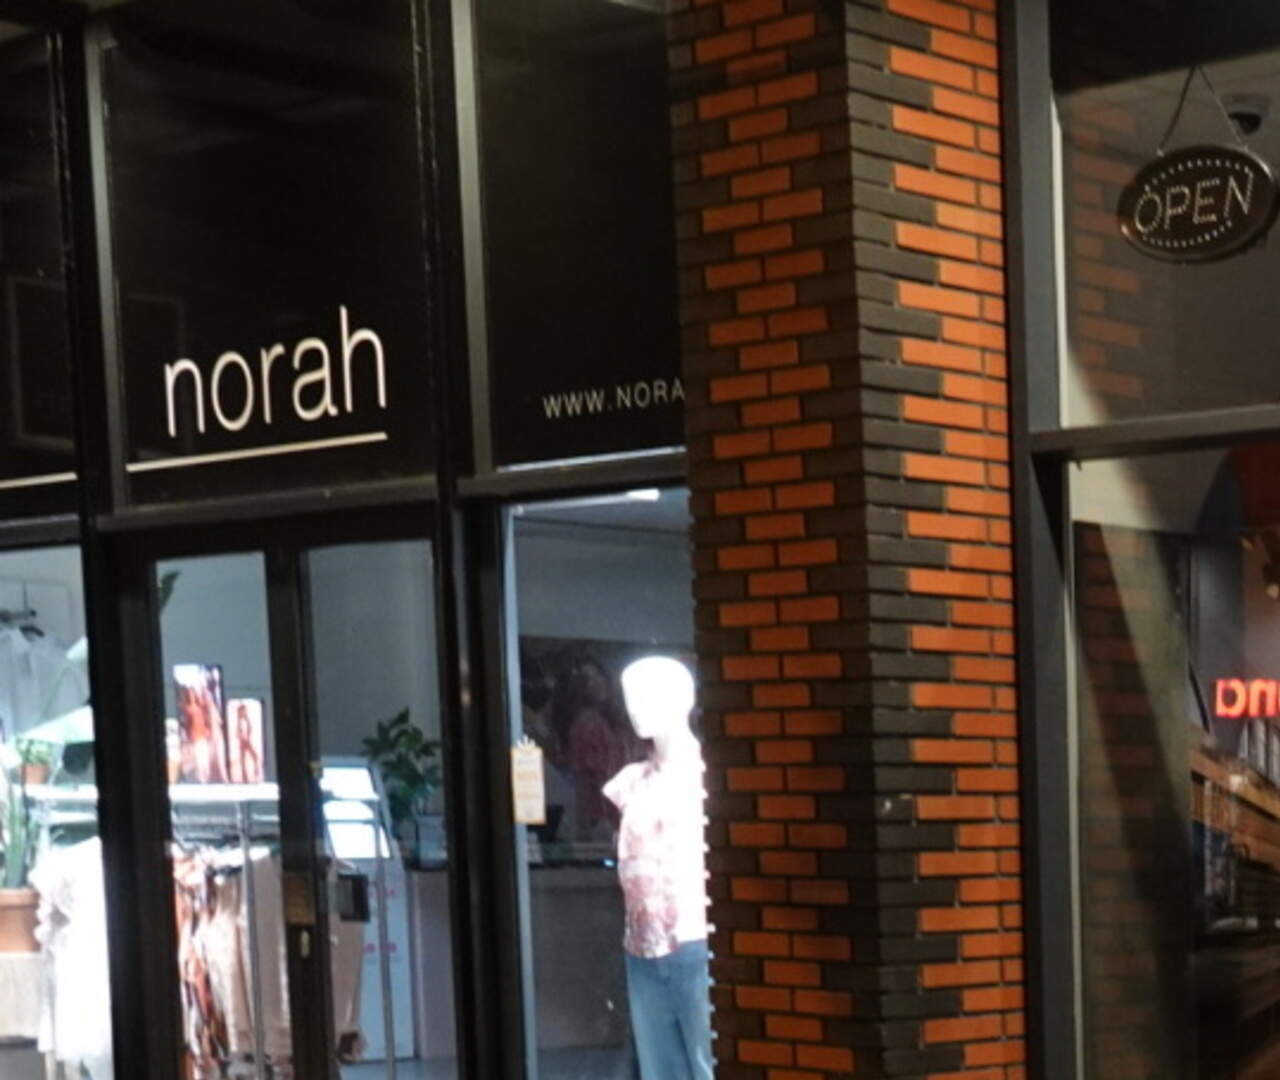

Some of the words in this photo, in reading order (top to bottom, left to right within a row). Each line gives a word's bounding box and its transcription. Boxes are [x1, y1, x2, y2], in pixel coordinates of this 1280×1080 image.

[1135, 171, 1254, 233] OPEN
[164, 304, 387, 438] norah
[542, 376, 686, 419] WWW.NORA
